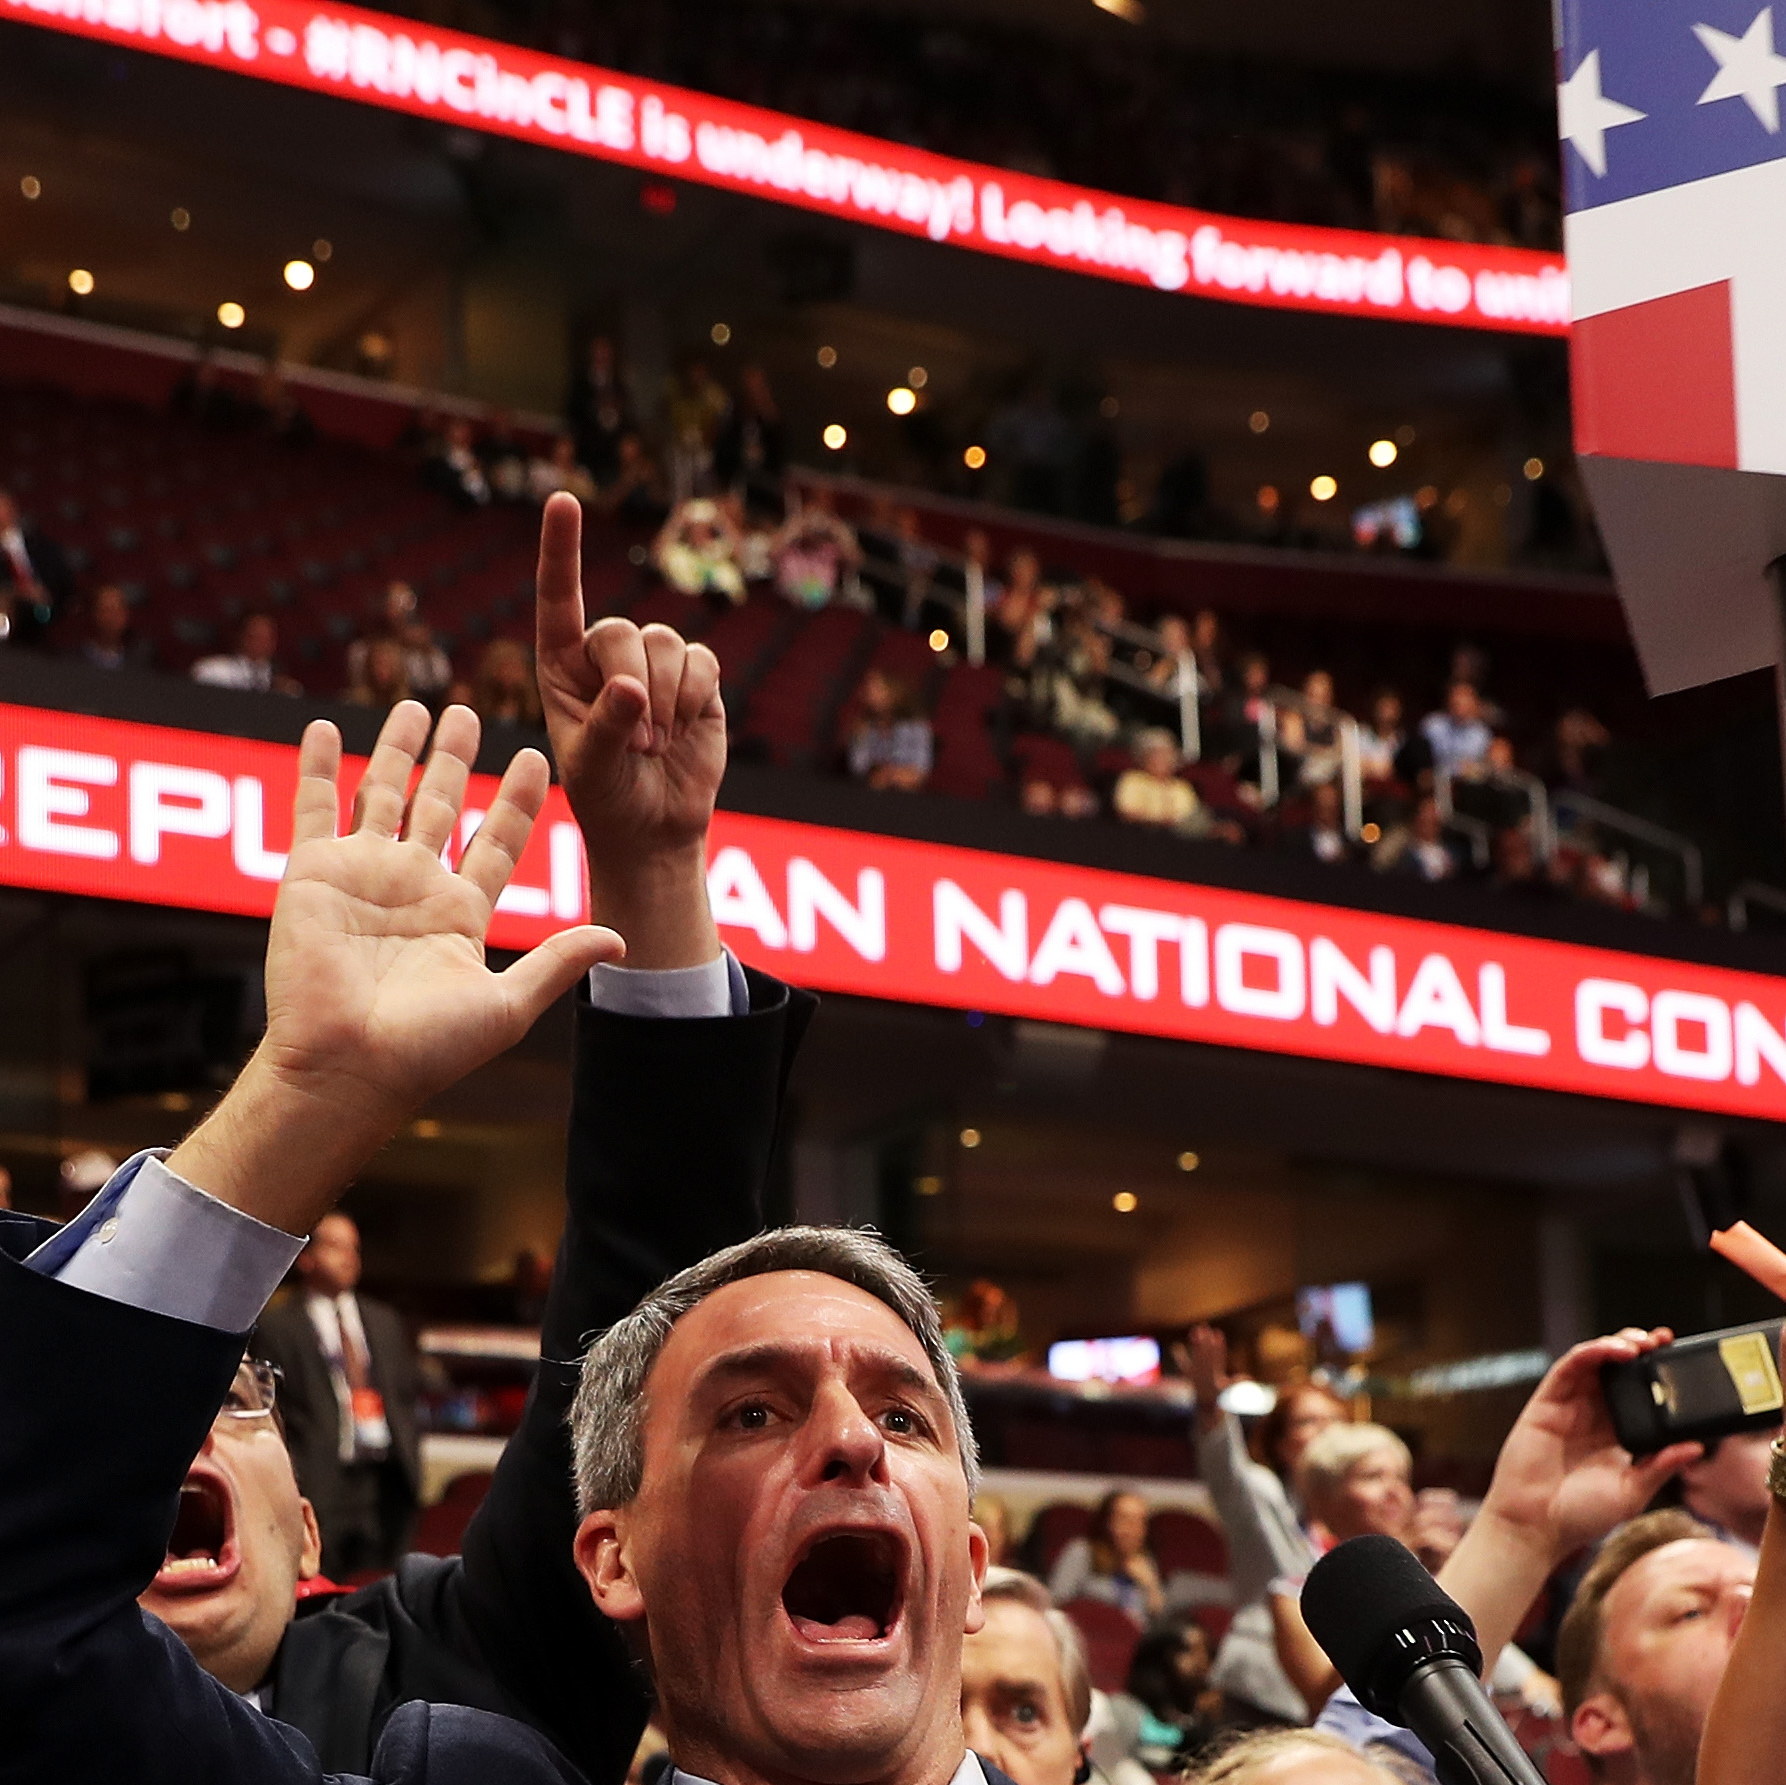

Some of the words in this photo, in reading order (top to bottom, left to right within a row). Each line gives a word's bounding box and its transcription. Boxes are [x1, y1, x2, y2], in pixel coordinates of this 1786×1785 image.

[304, 17, 635, 151] #RNCinCLE
[641, 96, 692, 162] is
[697, 123, 975, 241] underway!
[980, 183, 1189, 290] Looking
[1187, 226, 1404, 308] forward
[1406, 256, 1472, 314] to
[932, 875, 1551, 1058] NATIONAL
